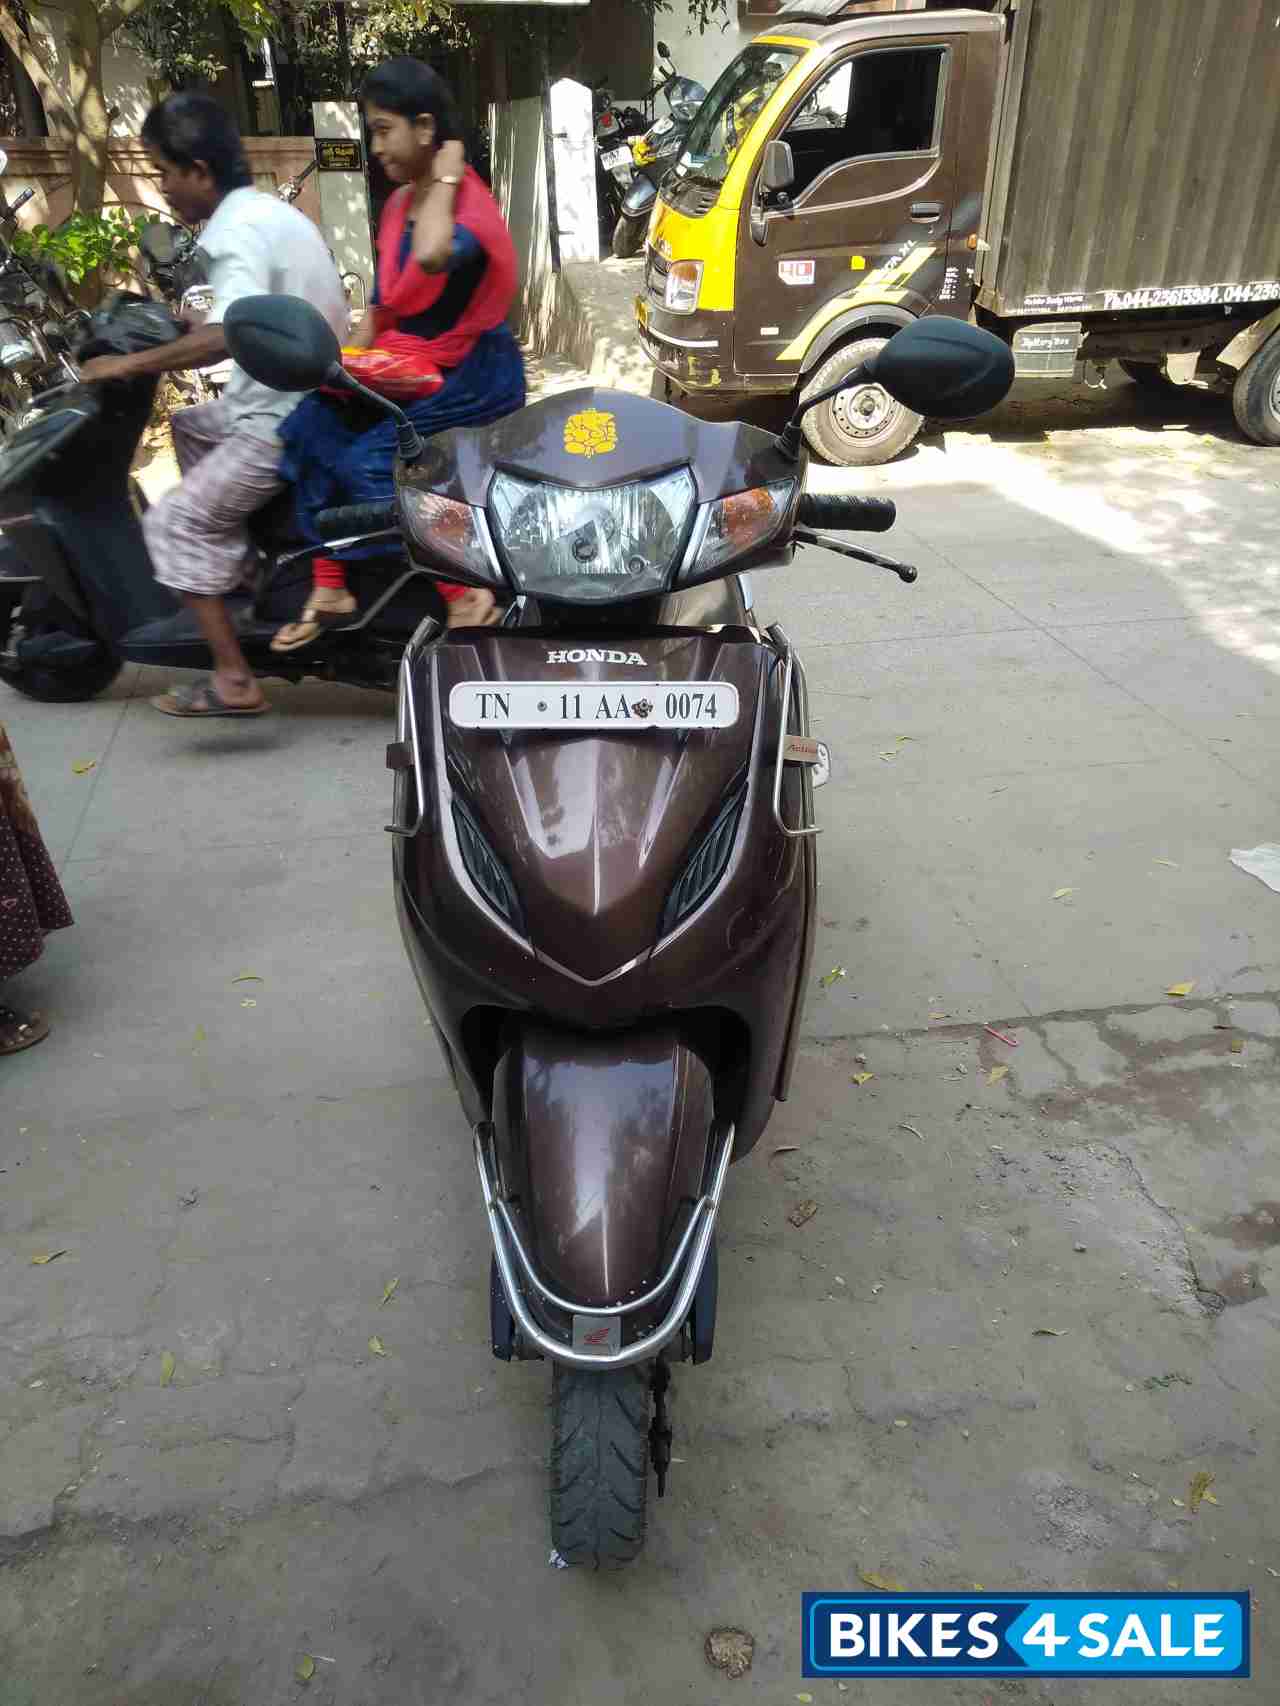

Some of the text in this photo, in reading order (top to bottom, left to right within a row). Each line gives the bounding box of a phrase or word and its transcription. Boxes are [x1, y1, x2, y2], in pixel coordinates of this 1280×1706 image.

[546, 648, 648, 666] HONDA
[476, 693, 717, 720] TN 11 AA 0074
